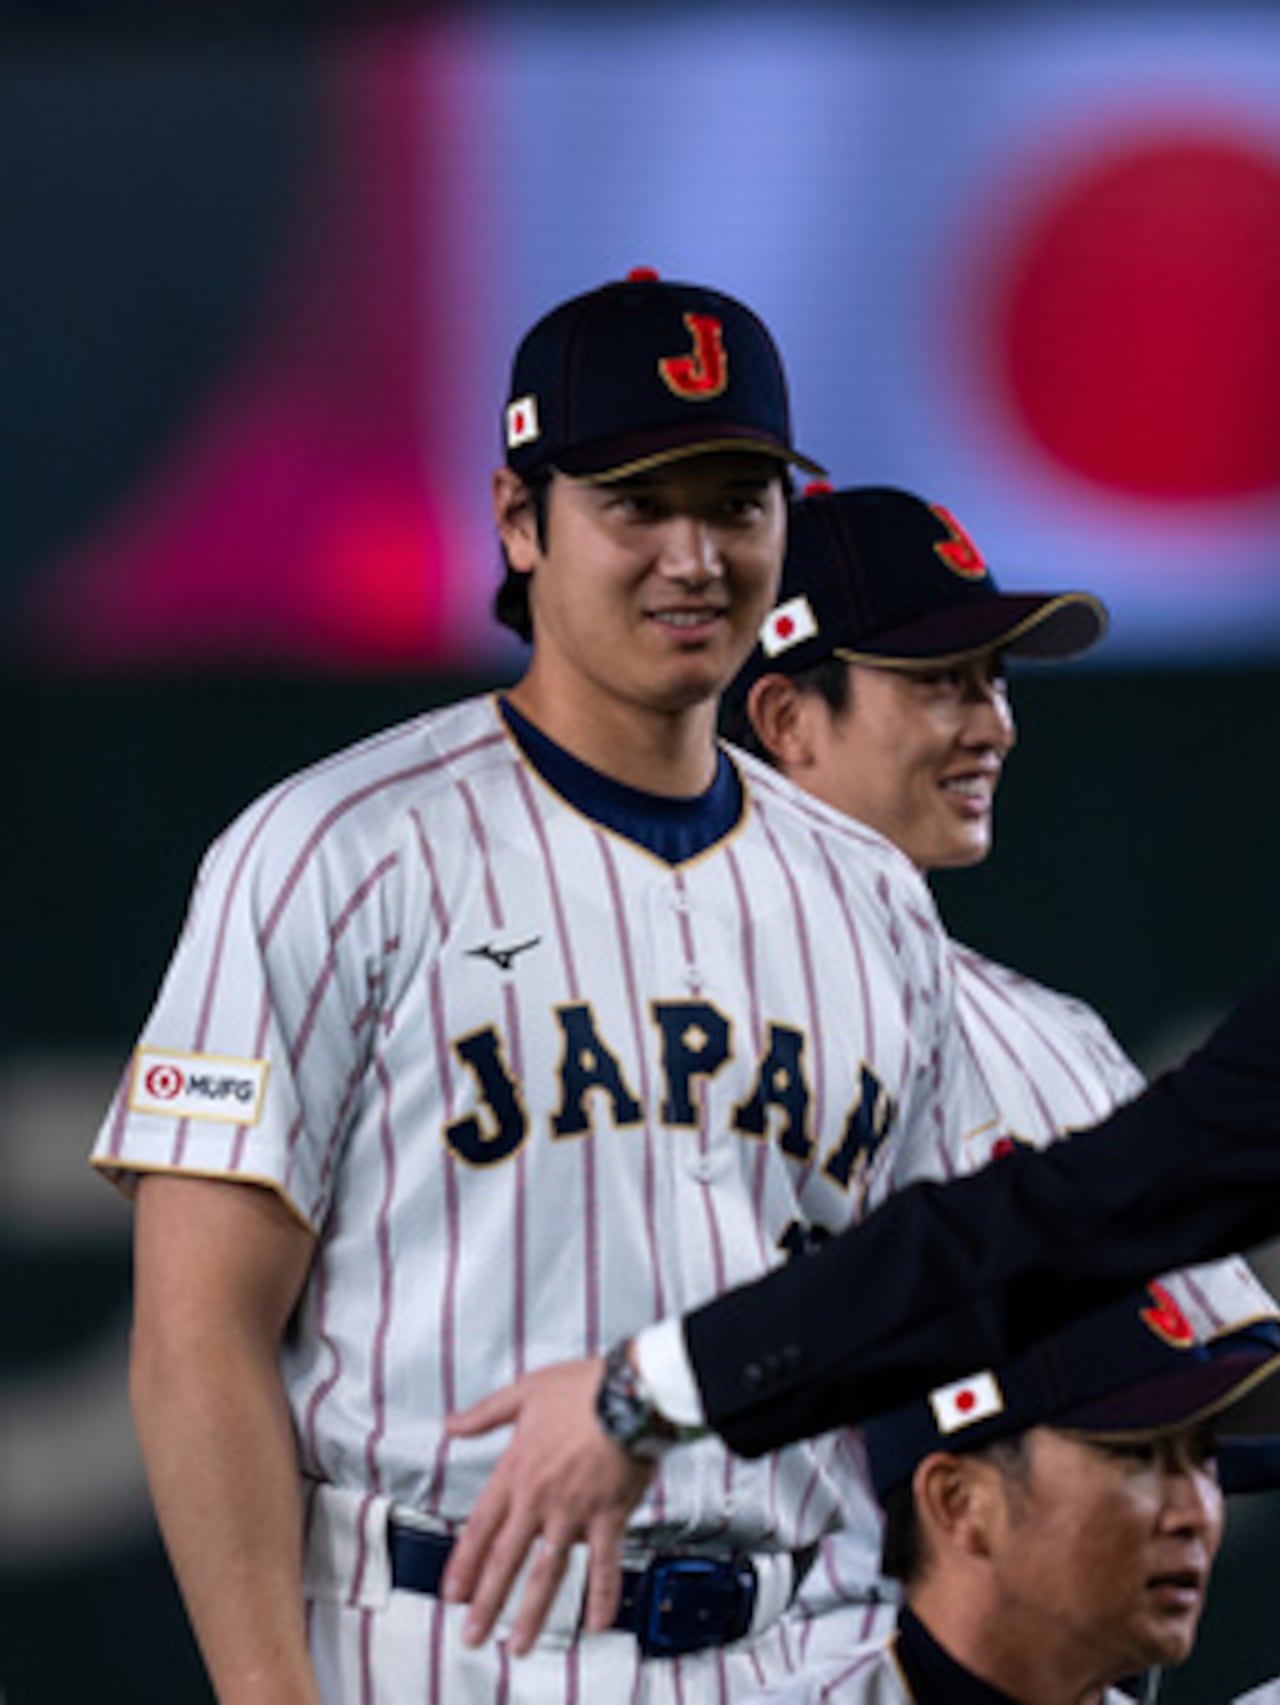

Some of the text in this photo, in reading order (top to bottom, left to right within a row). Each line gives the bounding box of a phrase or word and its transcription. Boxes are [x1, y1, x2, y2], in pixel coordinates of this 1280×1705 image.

[659, 312, 728, 399] J
[931, 504, 987, 577] J
[186, 1074, 254, 1104] MUFG
[443, 998, 898, 1195] JAPAN
[1139, 1278, 1195, 1349] J
